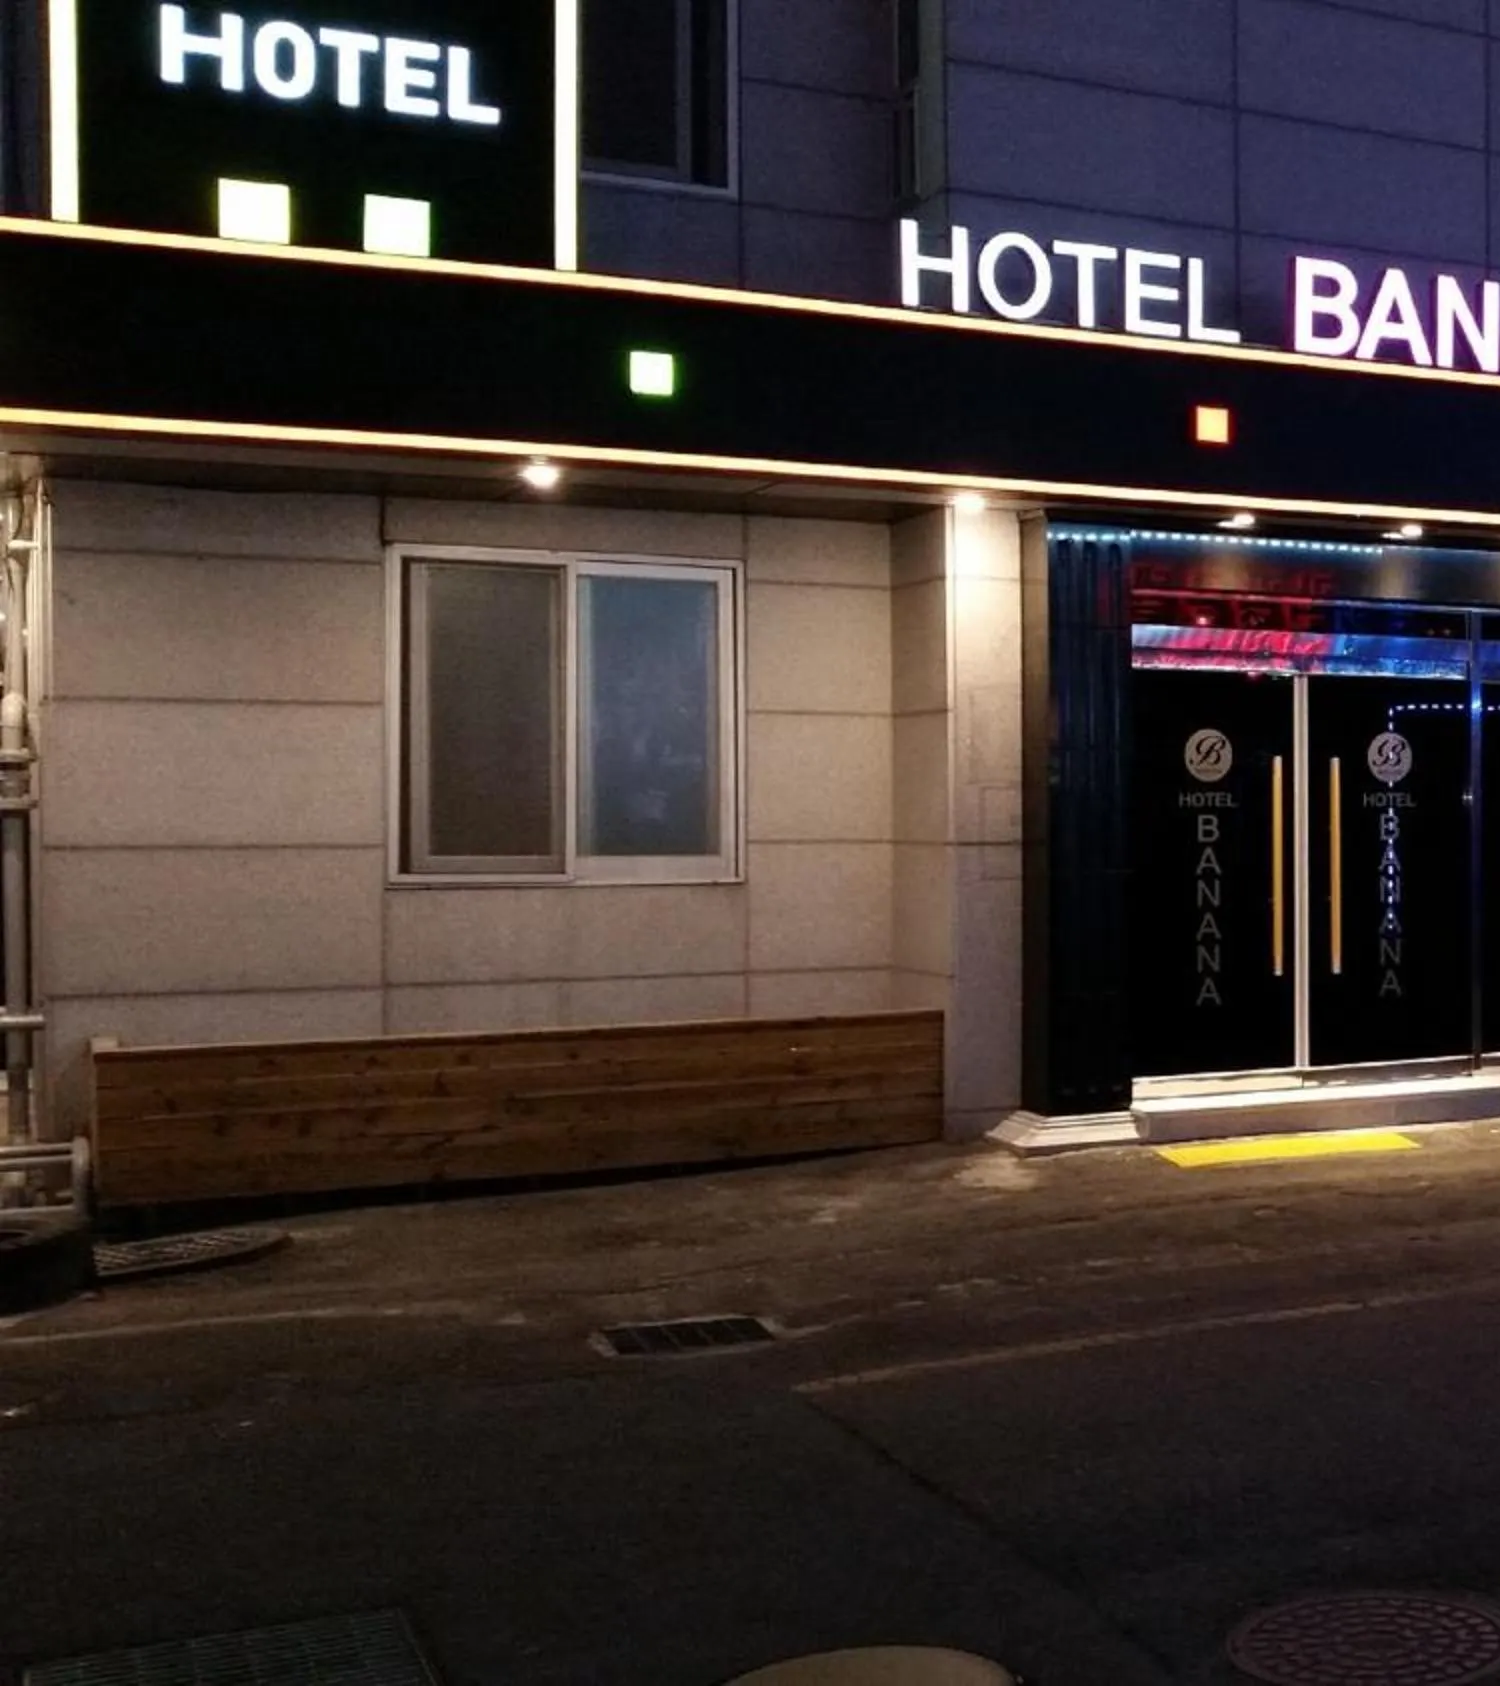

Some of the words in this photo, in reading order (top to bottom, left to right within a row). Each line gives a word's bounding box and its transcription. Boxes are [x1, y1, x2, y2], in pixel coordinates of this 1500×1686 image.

[158, 3, 501, 126] HOTEL
[898, 217, 1241, 344] HOTEL
[1178, 791, 1239, 809] HOTEL
[1361, 791, 1417, 809] HOTEL
[1195, 813, 1223, 1007] BANANA
[1377, 811, 1403, 998] BANANA
